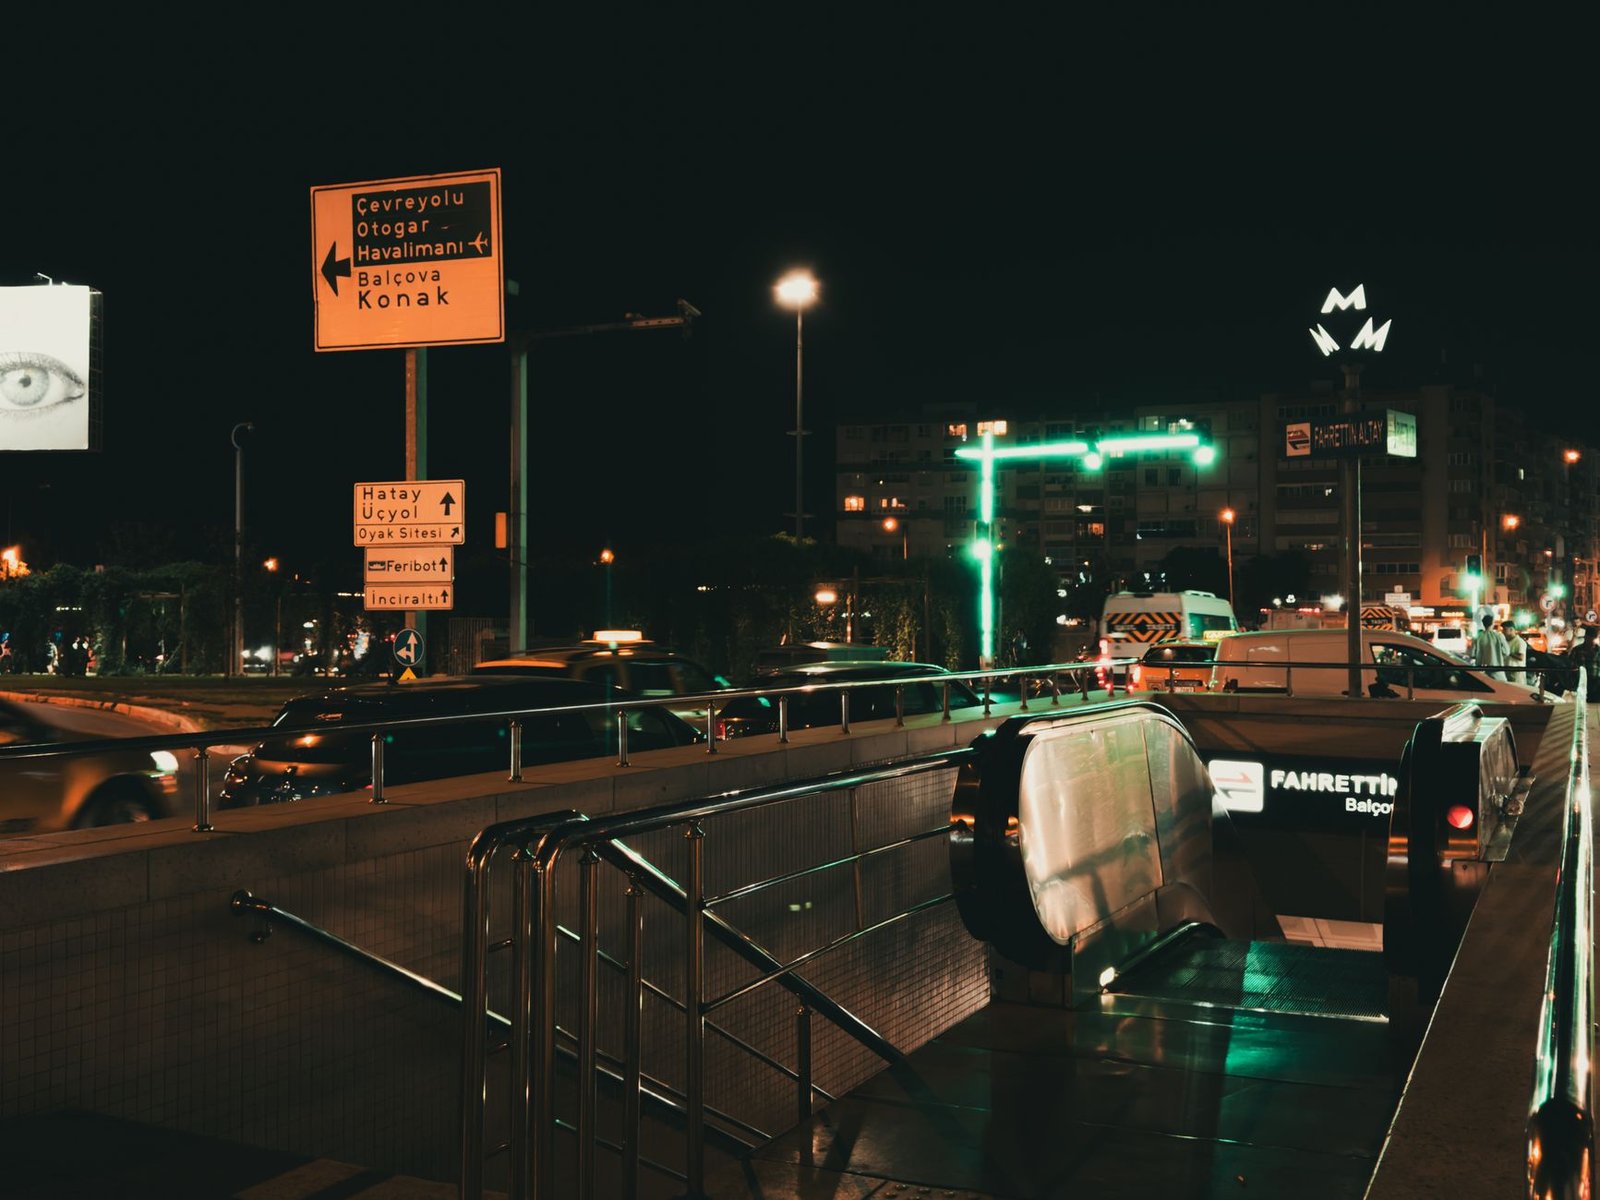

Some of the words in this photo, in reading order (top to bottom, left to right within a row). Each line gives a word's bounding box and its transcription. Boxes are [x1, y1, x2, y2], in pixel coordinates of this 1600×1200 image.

[357, 190, 464, 215] Çevreyolu
[357, 220, 429, 238] Otogar
[357, 241, 464, 261] Havalimanı
[358, 269, 441, 286] Balçova
[358, 286, 449, 310] Konak
[363, 487, 421, 503] Hatay
[362, 503, 418, 523] Üçyol
[358, 528, 394, 542] Oyak
[399, 527, 442, 539] Sitesi
[387, 560, 437, 572] Feribot
[372, 590, 439, 605] İnciraltı
